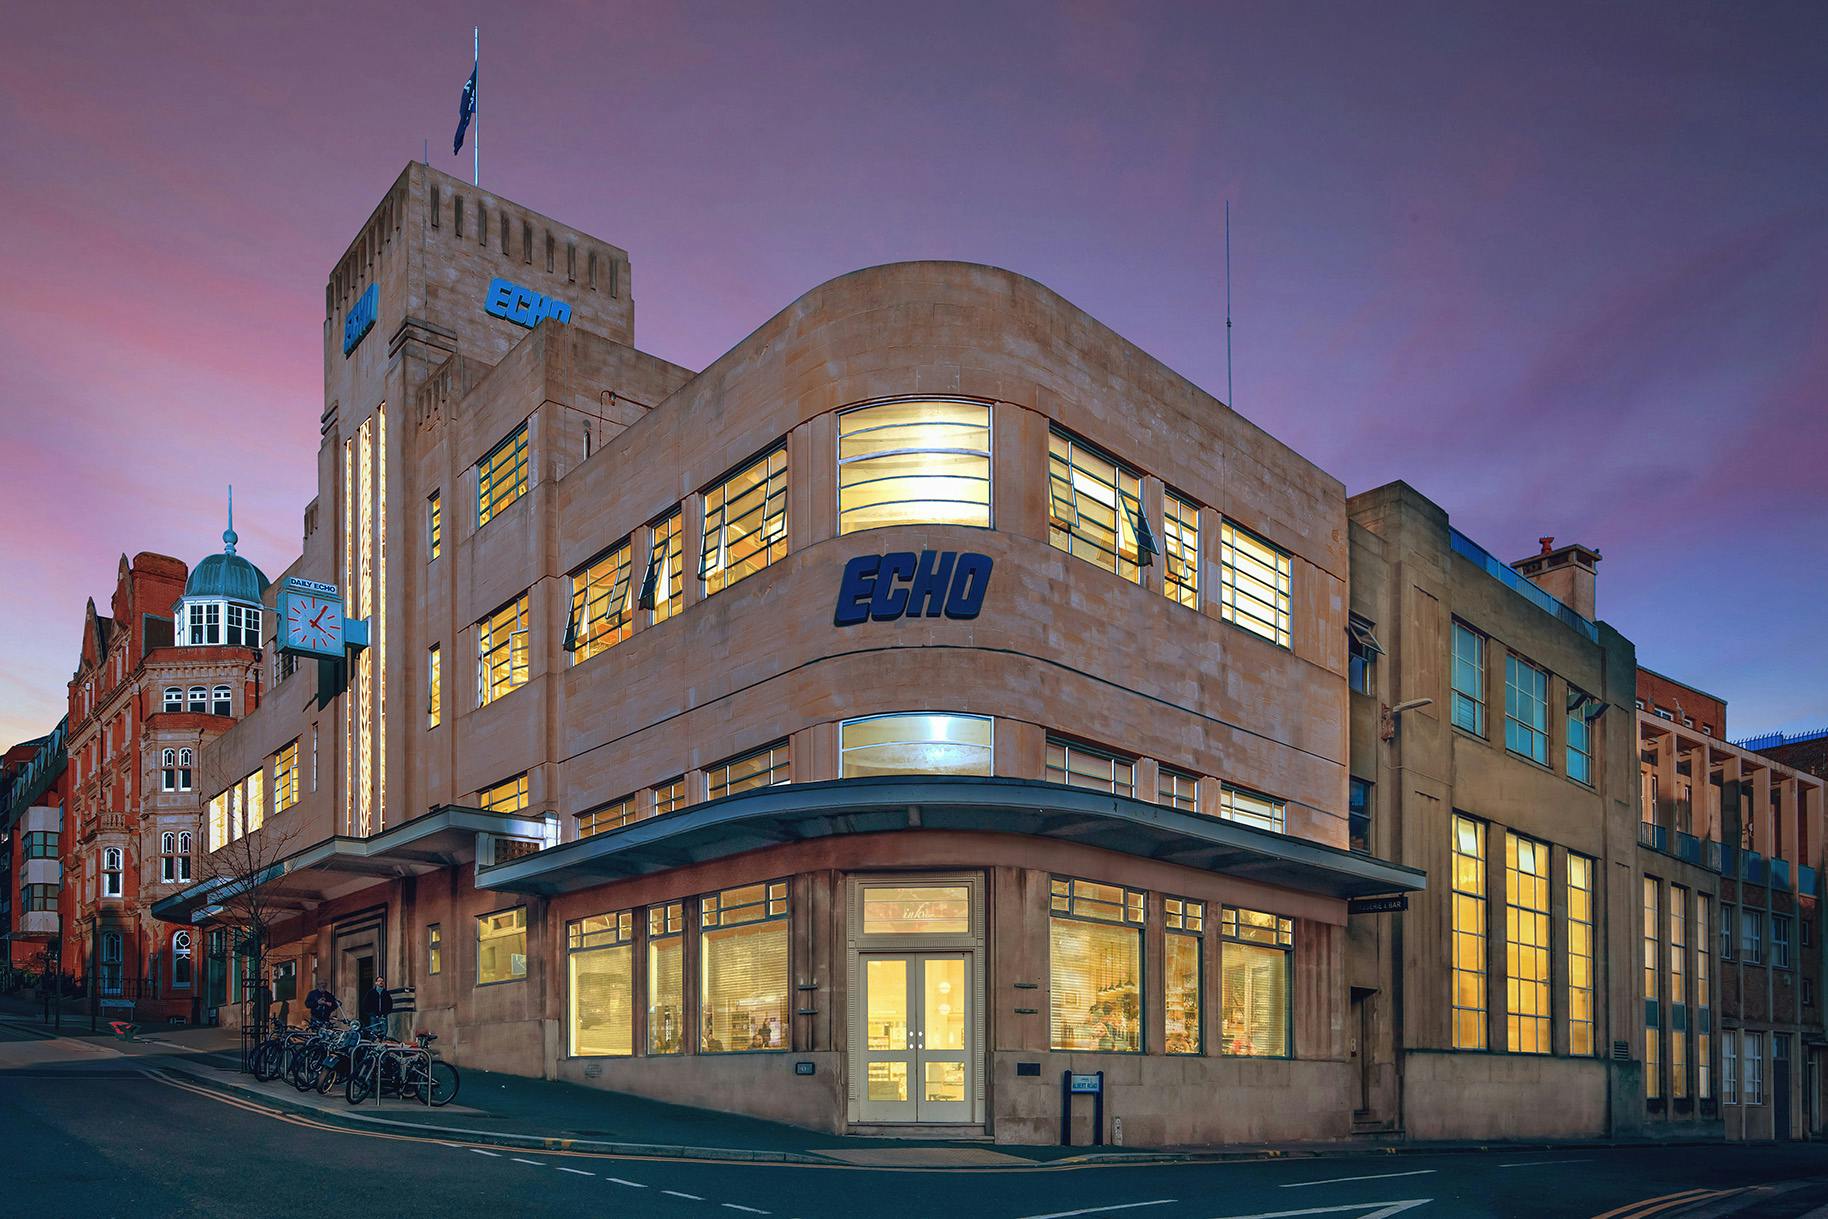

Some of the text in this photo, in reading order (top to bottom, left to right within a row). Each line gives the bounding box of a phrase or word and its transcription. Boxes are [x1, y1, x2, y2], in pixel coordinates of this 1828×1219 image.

[290, 578, 336, 593] DAILY ECHO
[834, 550, 993, 628] ECHO
